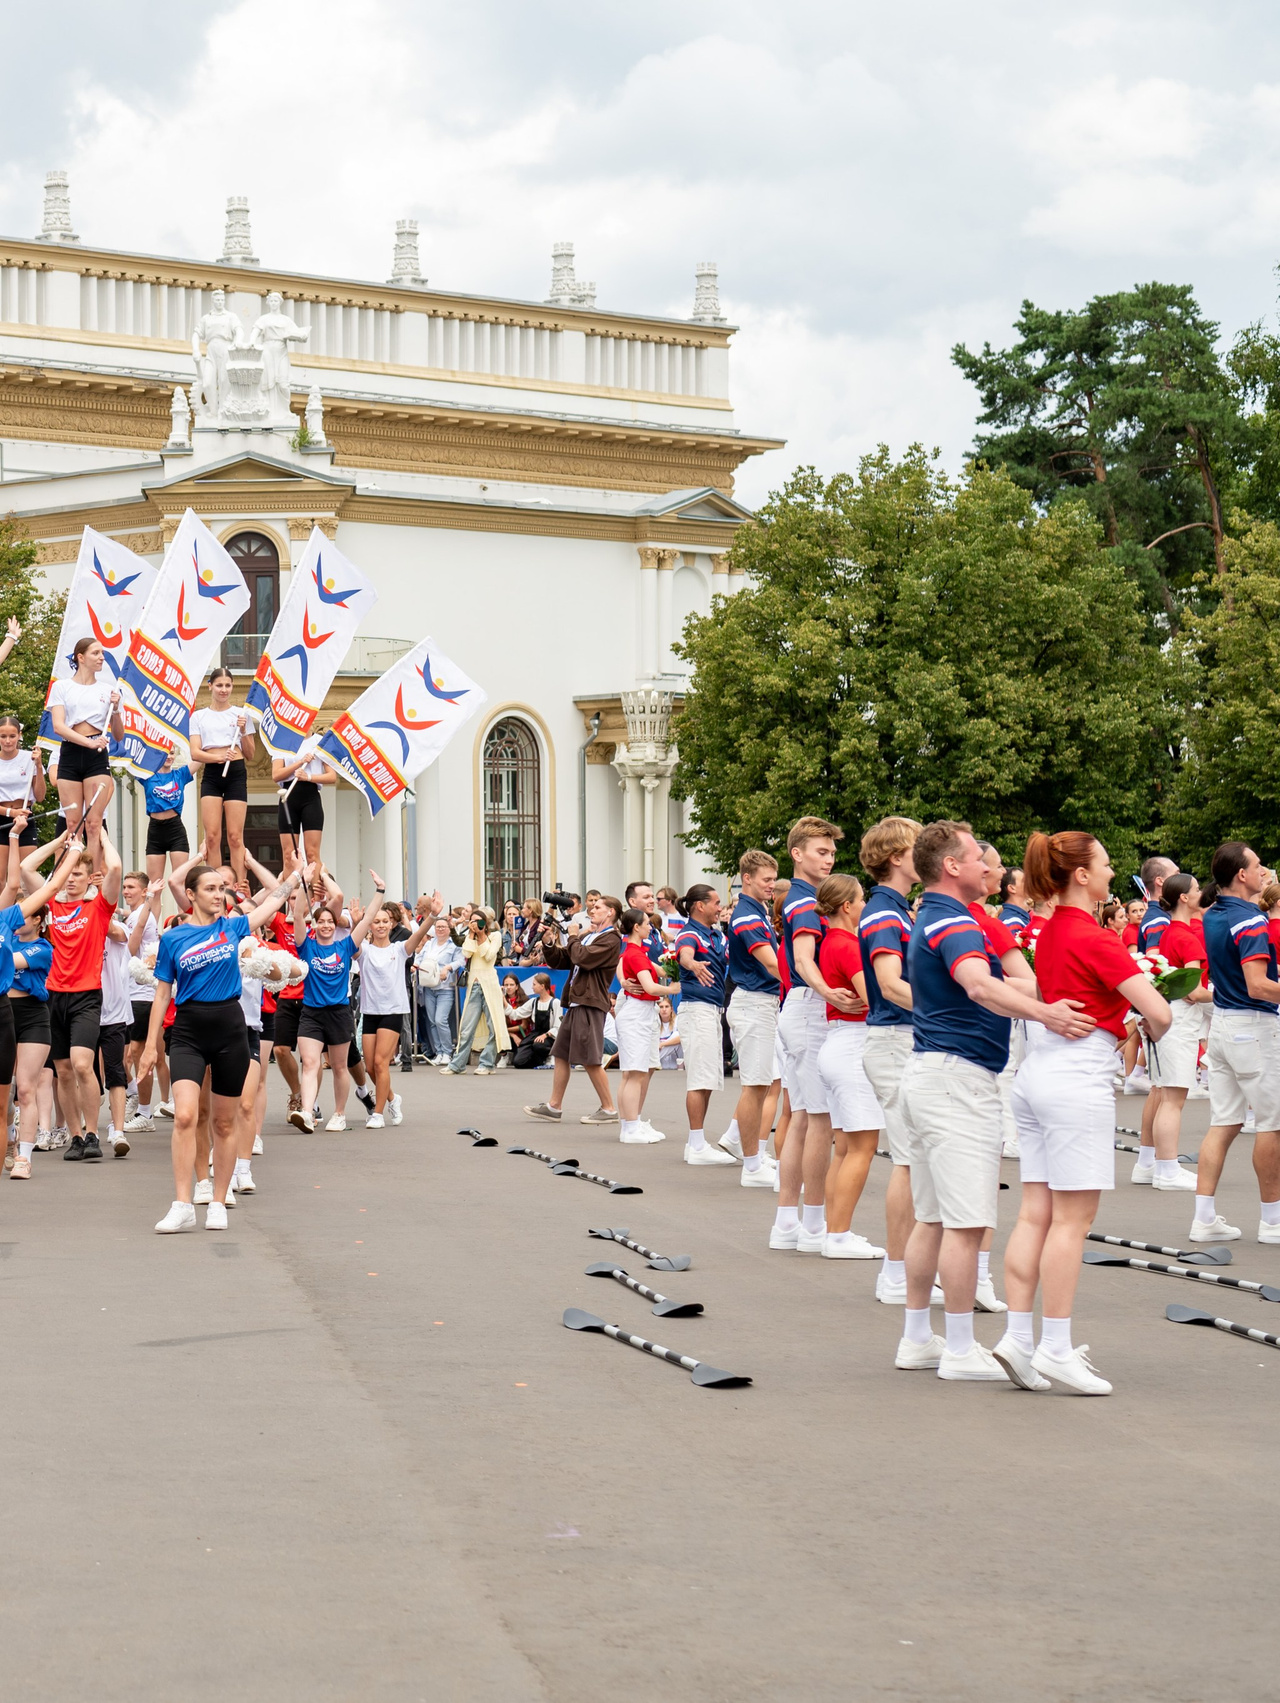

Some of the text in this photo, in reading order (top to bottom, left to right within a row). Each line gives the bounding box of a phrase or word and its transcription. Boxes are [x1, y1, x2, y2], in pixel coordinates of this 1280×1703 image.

[137, 644, 165, 676] СОЮЗ
[165, 664, 183, 689] ЧИР
[141, 684, 187, 727] РОССИИ
[275, 696, 310, 729] СПОРТА
[341, 723, 399, 796] СОЮЗ ЧИР СПОРТА
[180, 944, 234, 969] СПОРТИВНОЕ
[187, 952, 231, 972] ШЕСТВИЕ
